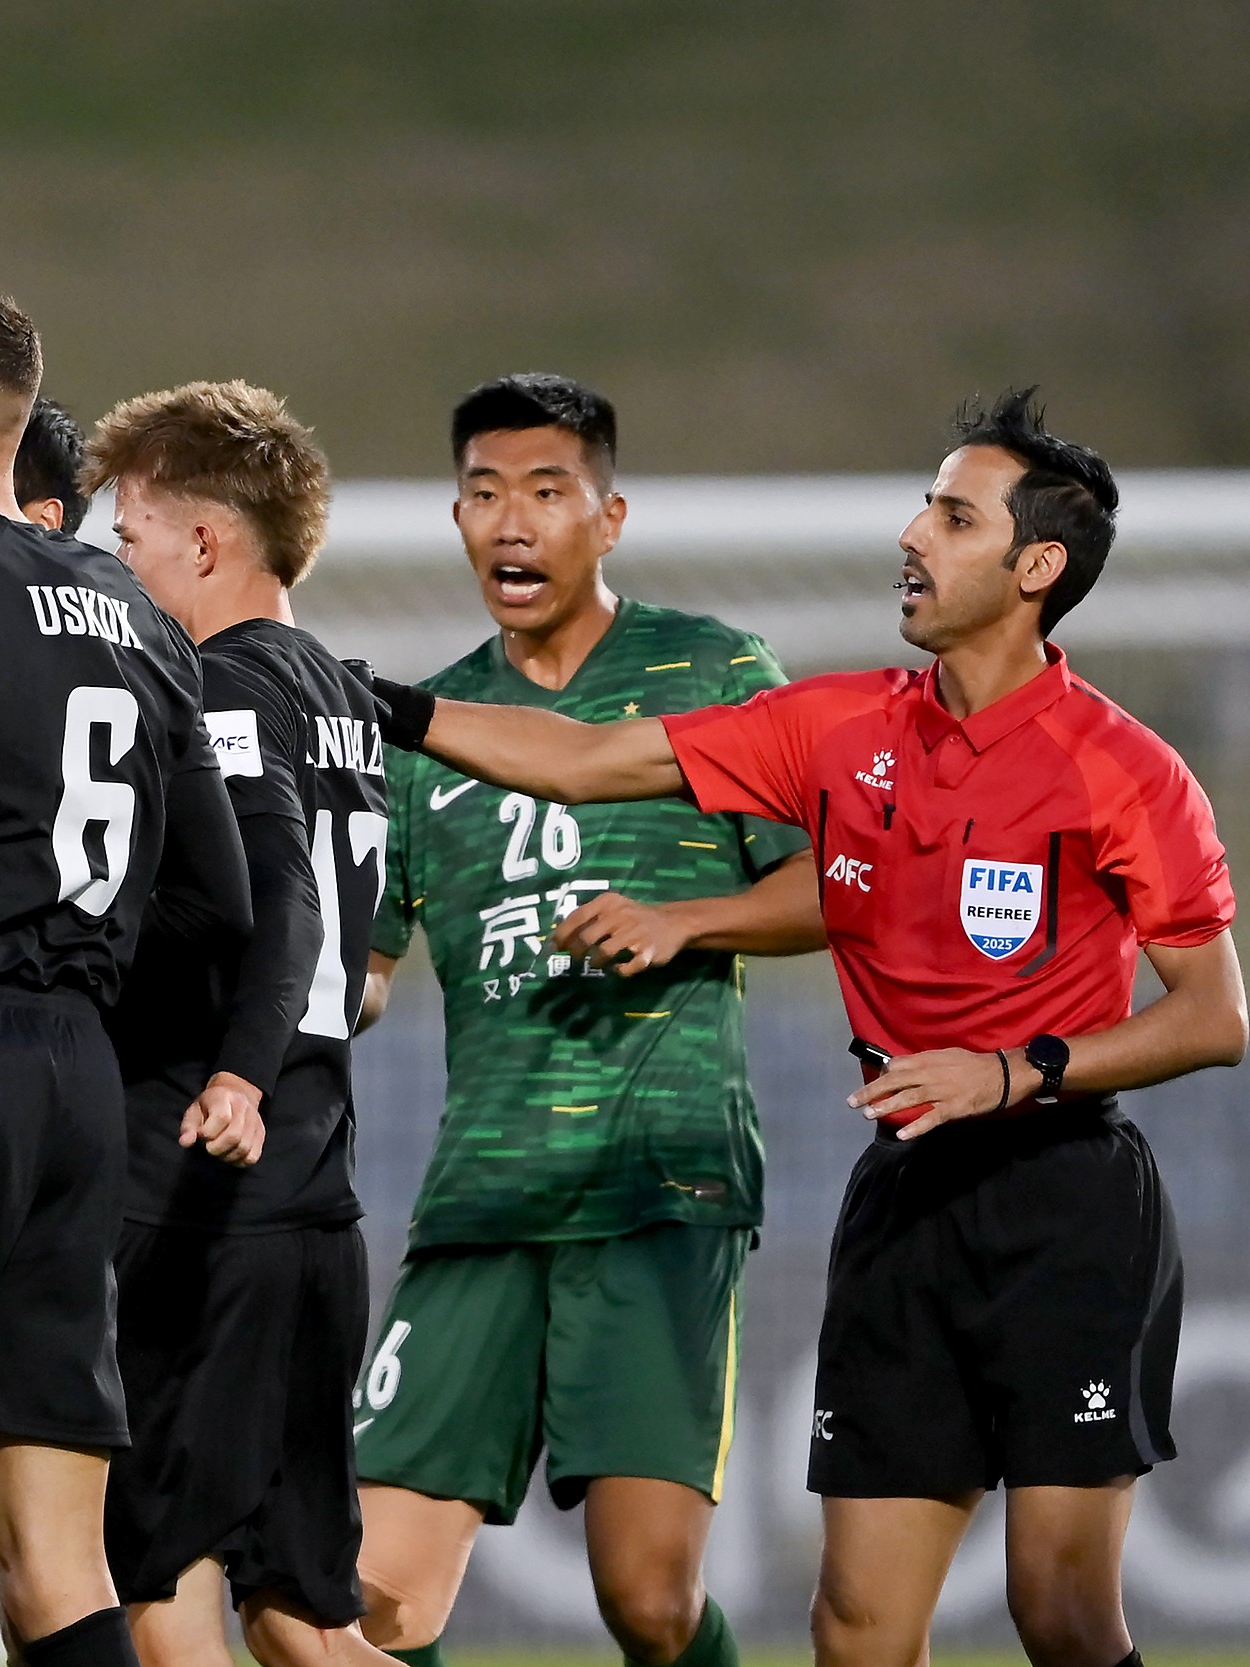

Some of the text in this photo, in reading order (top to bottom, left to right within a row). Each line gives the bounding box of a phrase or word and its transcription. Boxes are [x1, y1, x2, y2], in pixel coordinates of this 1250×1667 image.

[212, 735, 251, 751] AFC
[854, 770, 895, 791] KELME
[52, 685, 139, 917] 6
[498, 792, 582, 882] 26
[825, 853, 874, 893] AFC
[969, 866, 1034, 894] FIFA
[298, 808, 389, 1041] 17
[966, 905, 1033, 922] REFEREE
[982, 937, 1014, 951] 2025
[351, 1319, 412, 1411] 6
[811, 1409, 834, 1441] FC
[1073, 1408, 1117, 1424] KELME
